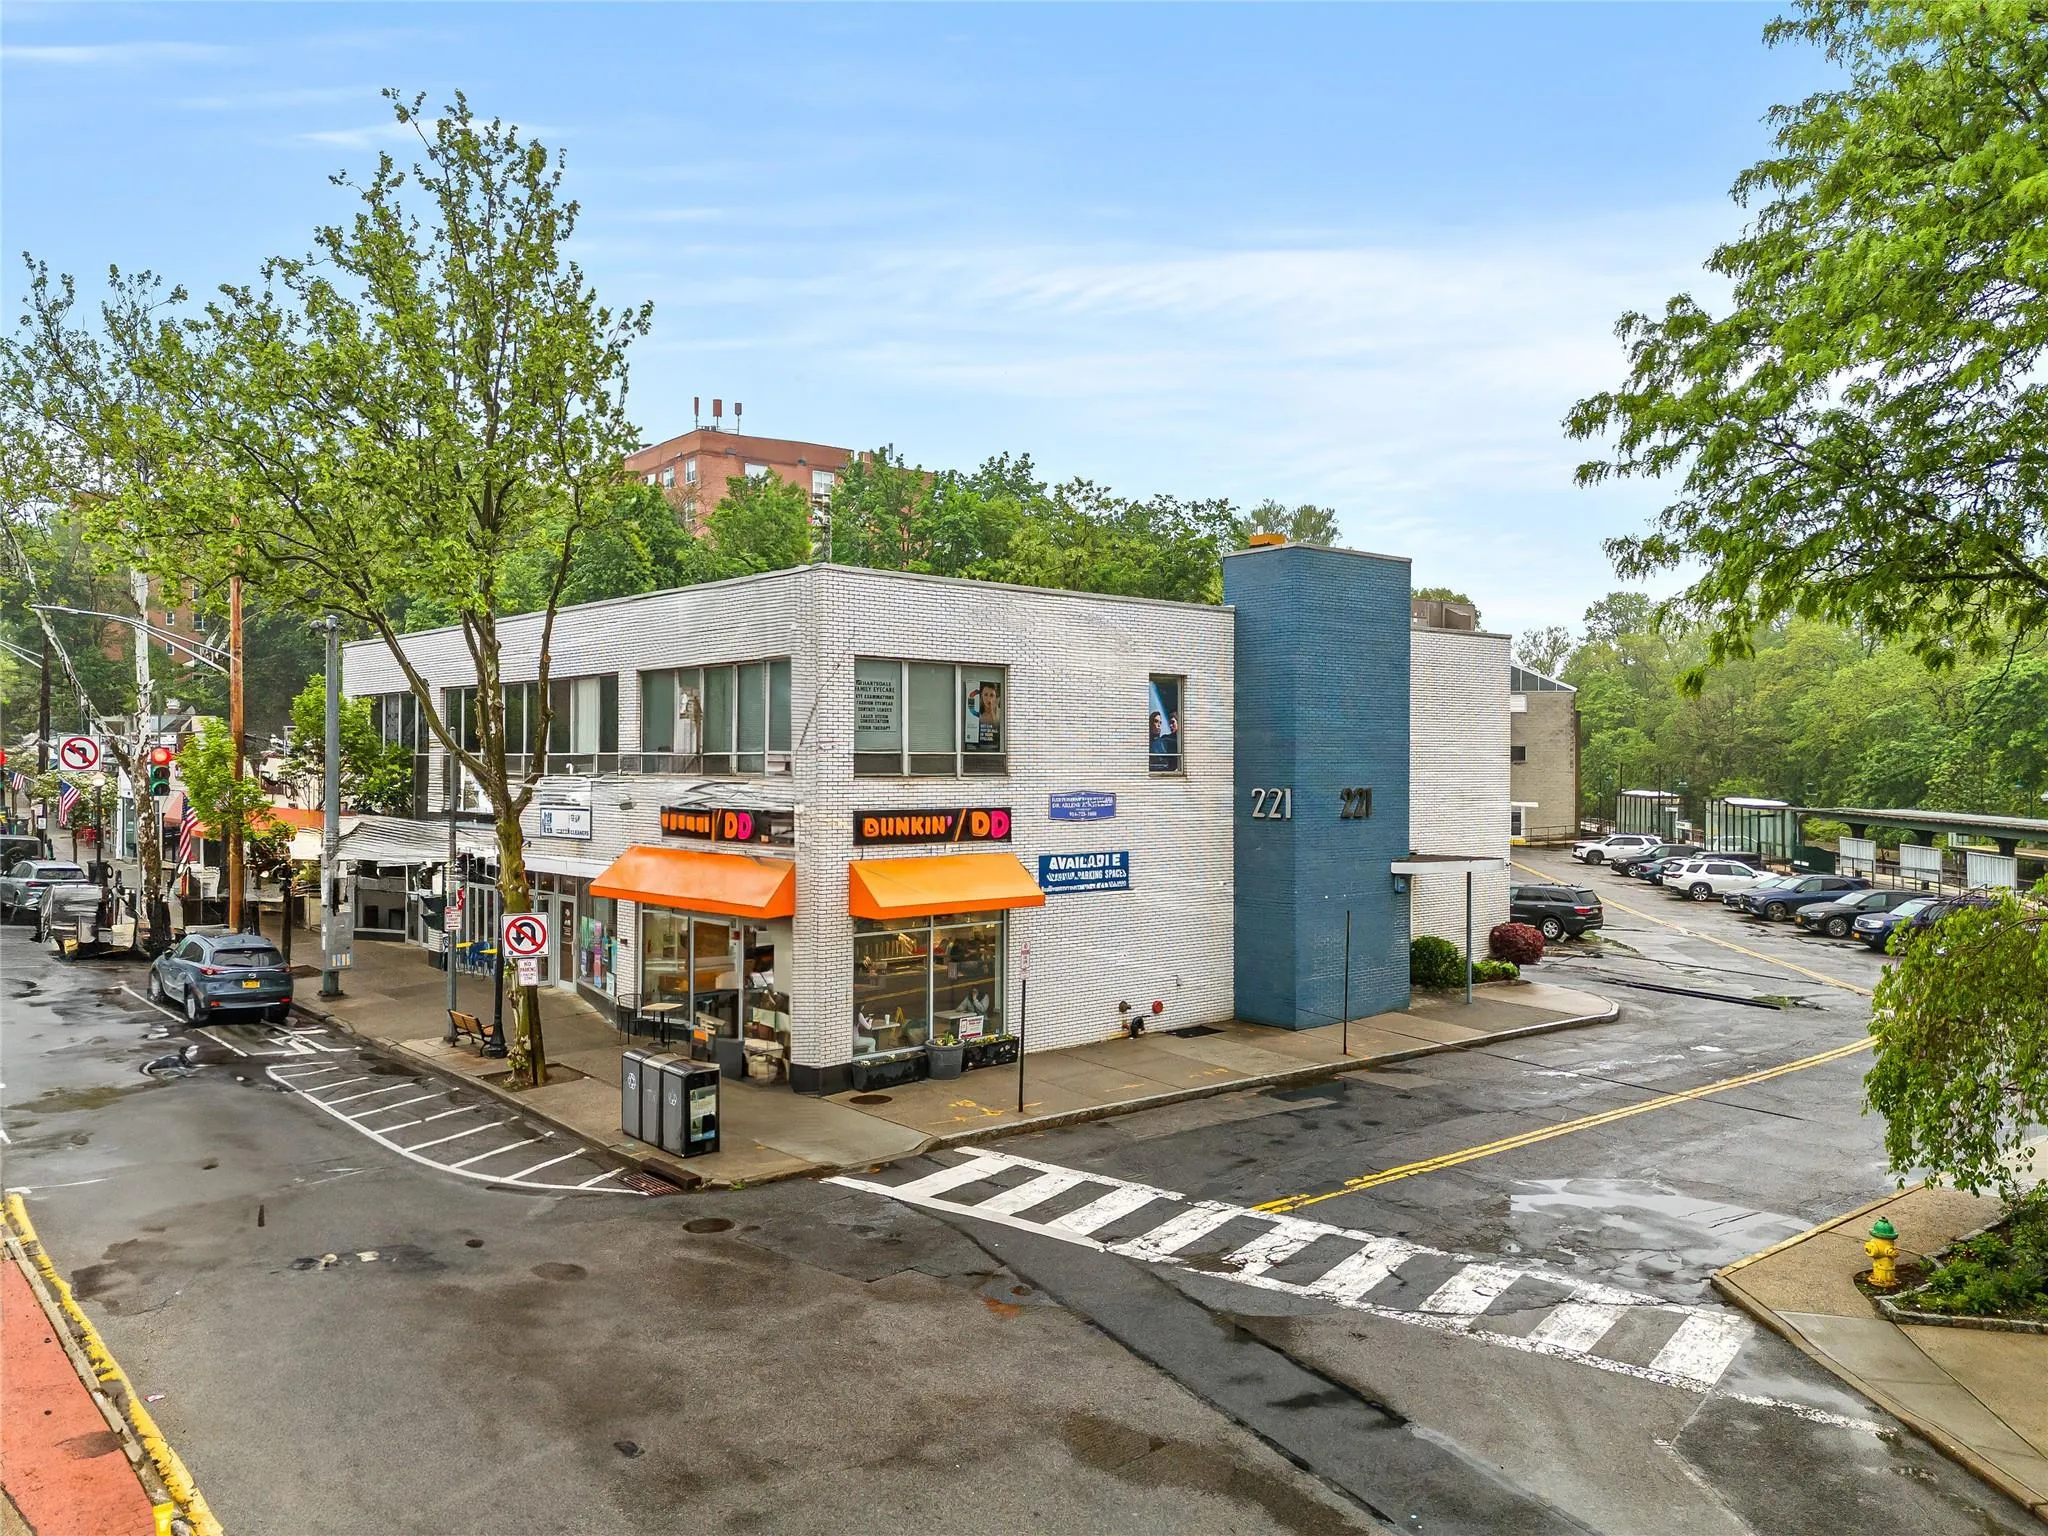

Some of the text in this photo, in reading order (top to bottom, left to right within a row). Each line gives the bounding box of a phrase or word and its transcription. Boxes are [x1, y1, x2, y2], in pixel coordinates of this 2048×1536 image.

[1251, 788, 1292, 818] 221
[1340, 787, 1373, 818] 221
[724, 812, 752, 840] DD
[863, 810, 1010, 838] DUNKIN' DD
[1078, 870, 1102, 880] PARKING
[1105, 869, 1126, 878] SPACES
